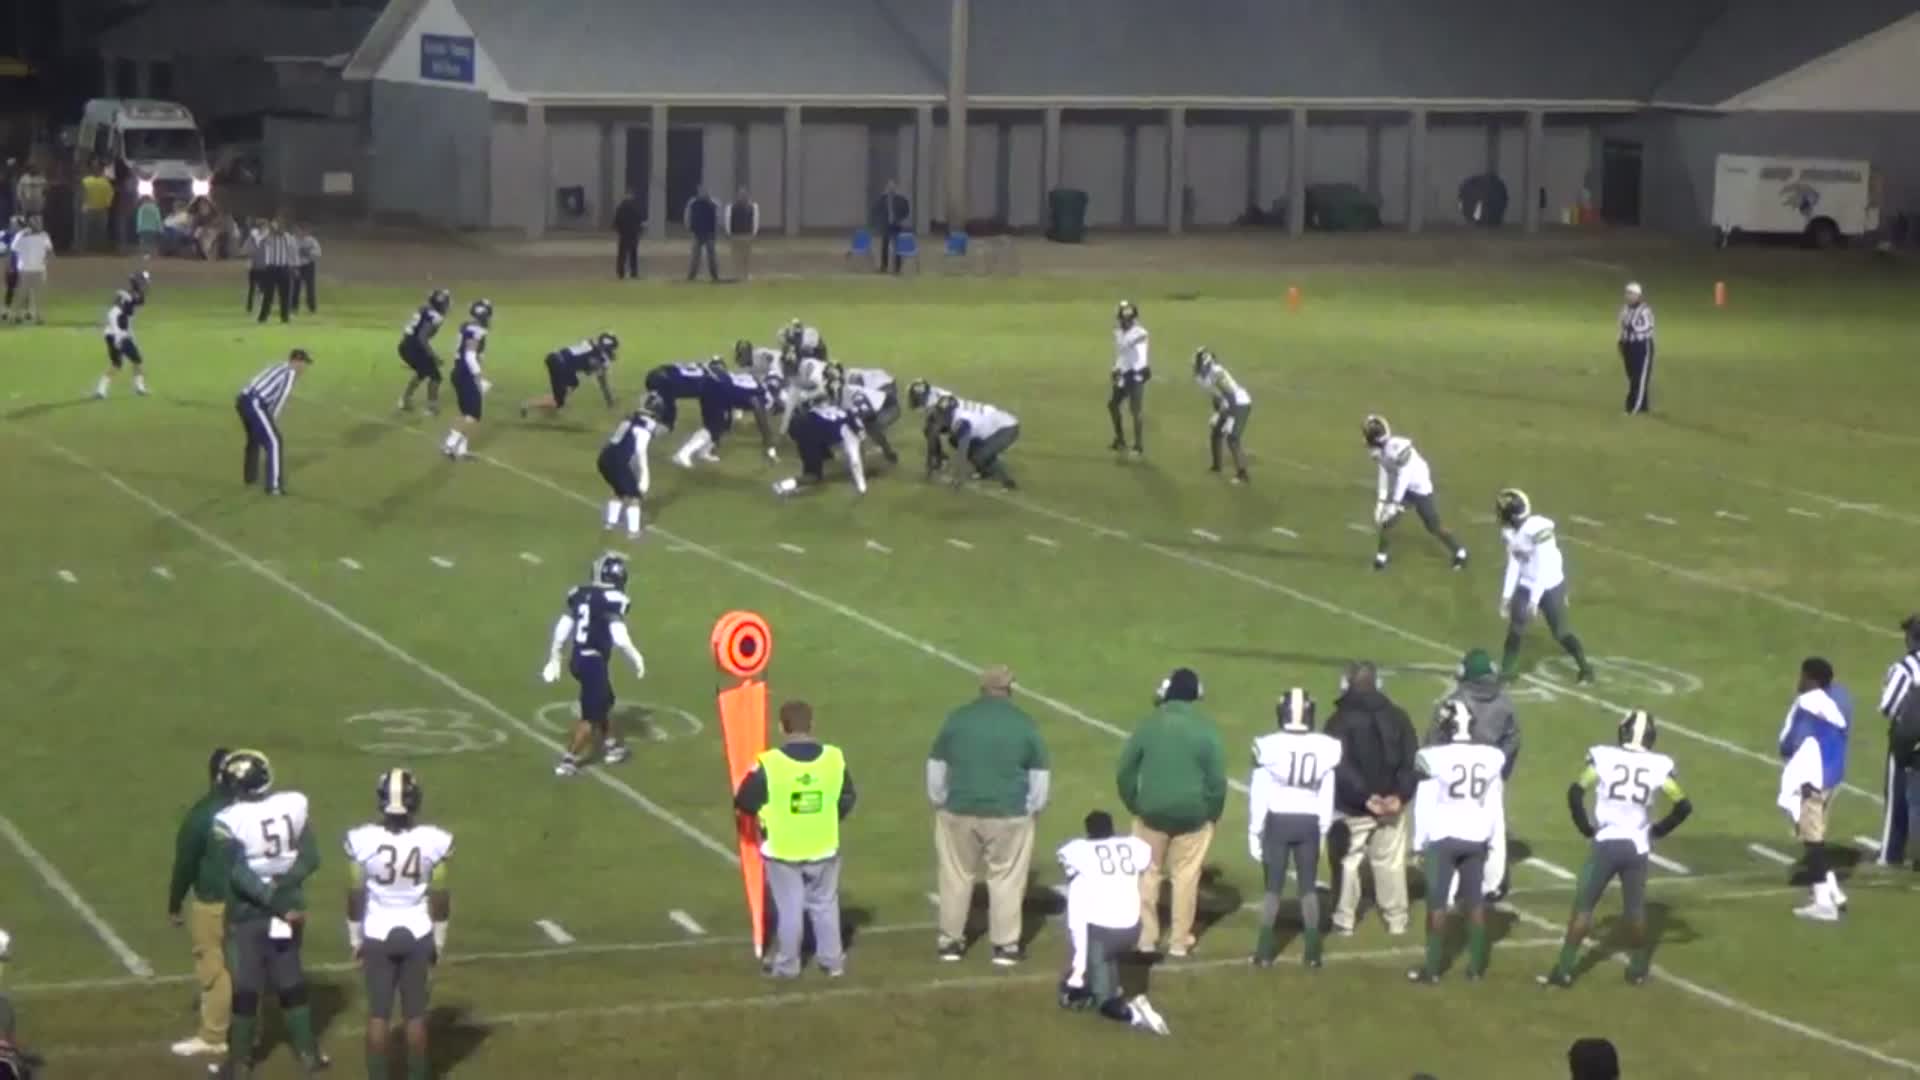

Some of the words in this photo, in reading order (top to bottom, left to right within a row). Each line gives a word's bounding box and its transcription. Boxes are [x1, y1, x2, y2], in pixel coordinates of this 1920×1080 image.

[576, 603, 590, 644] 2
[1287, 751, 1319, 789] 10
[1449, 763, 1488, 800] 26
[1608, 764, 1650, 805] 25
[260, 814, 297, 858] 51
[375, 844, 423, 886] 34
[1095, 844, 1136, 875] 88
